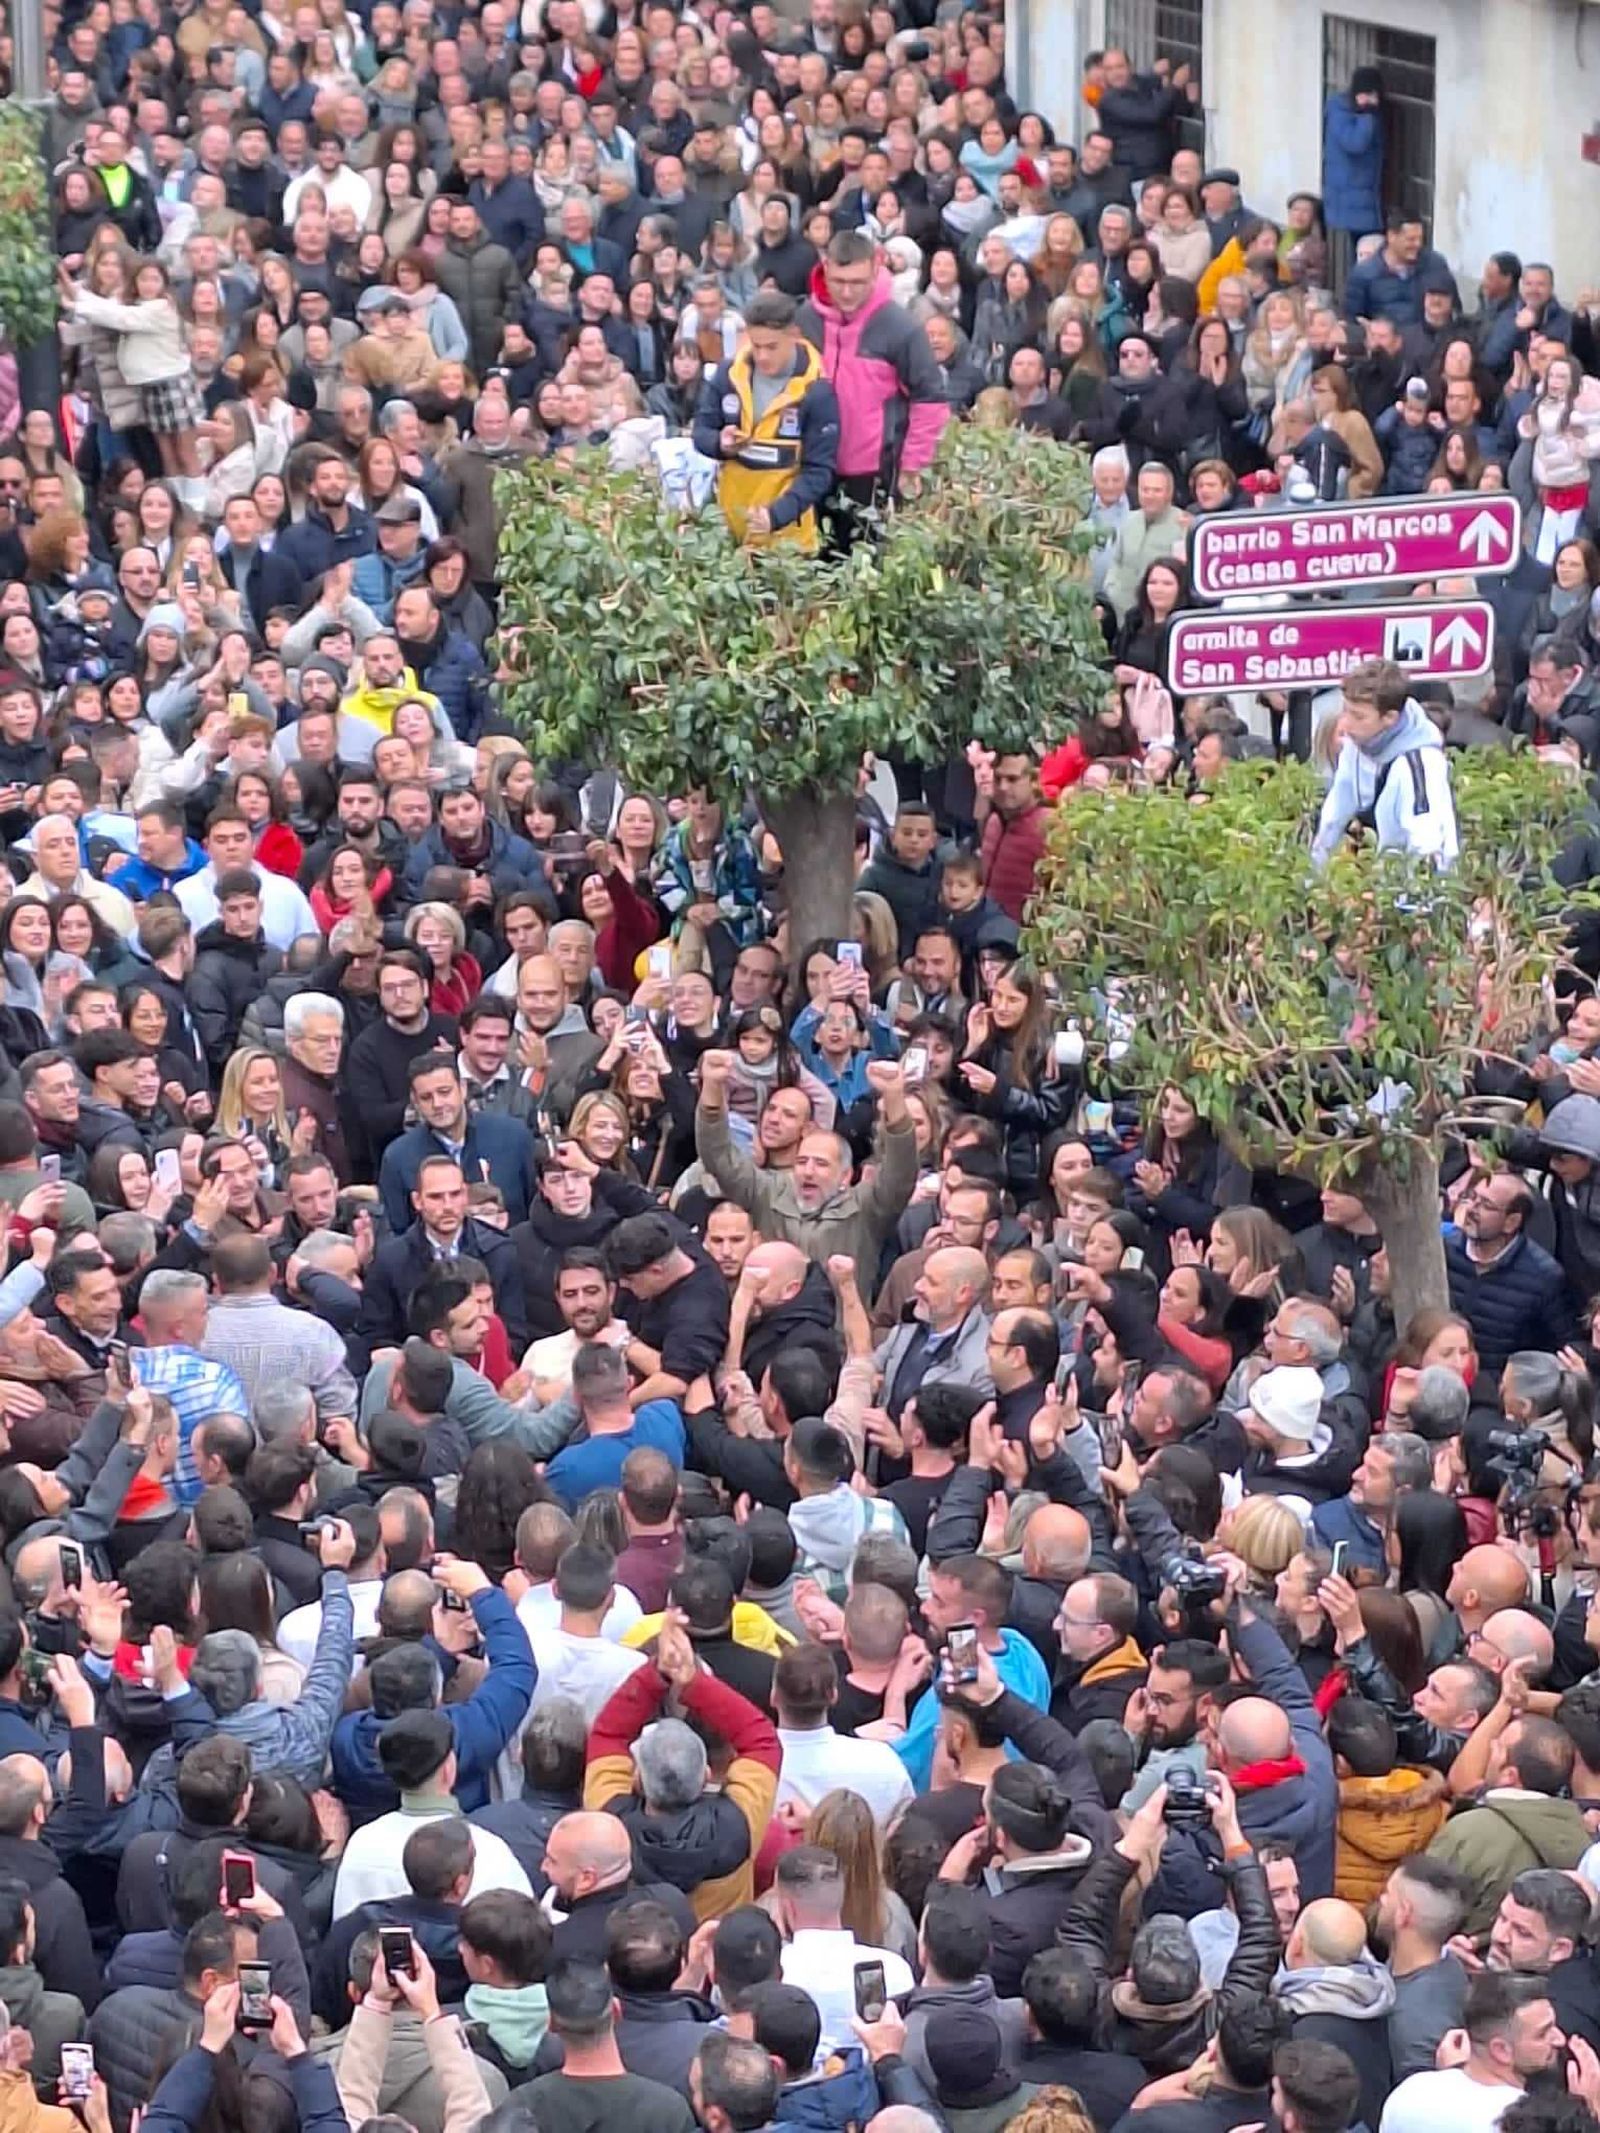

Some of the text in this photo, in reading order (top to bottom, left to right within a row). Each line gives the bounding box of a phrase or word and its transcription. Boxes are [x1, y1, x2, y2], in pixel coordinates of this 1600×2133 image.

[1207, 513, 1452, 553] barrio San Marcos
[1207, 542, 1396, 588] (casas cueva)
[1182, 623, 1299, 650] ermita de
[1182, 658, 1235, 684] San
